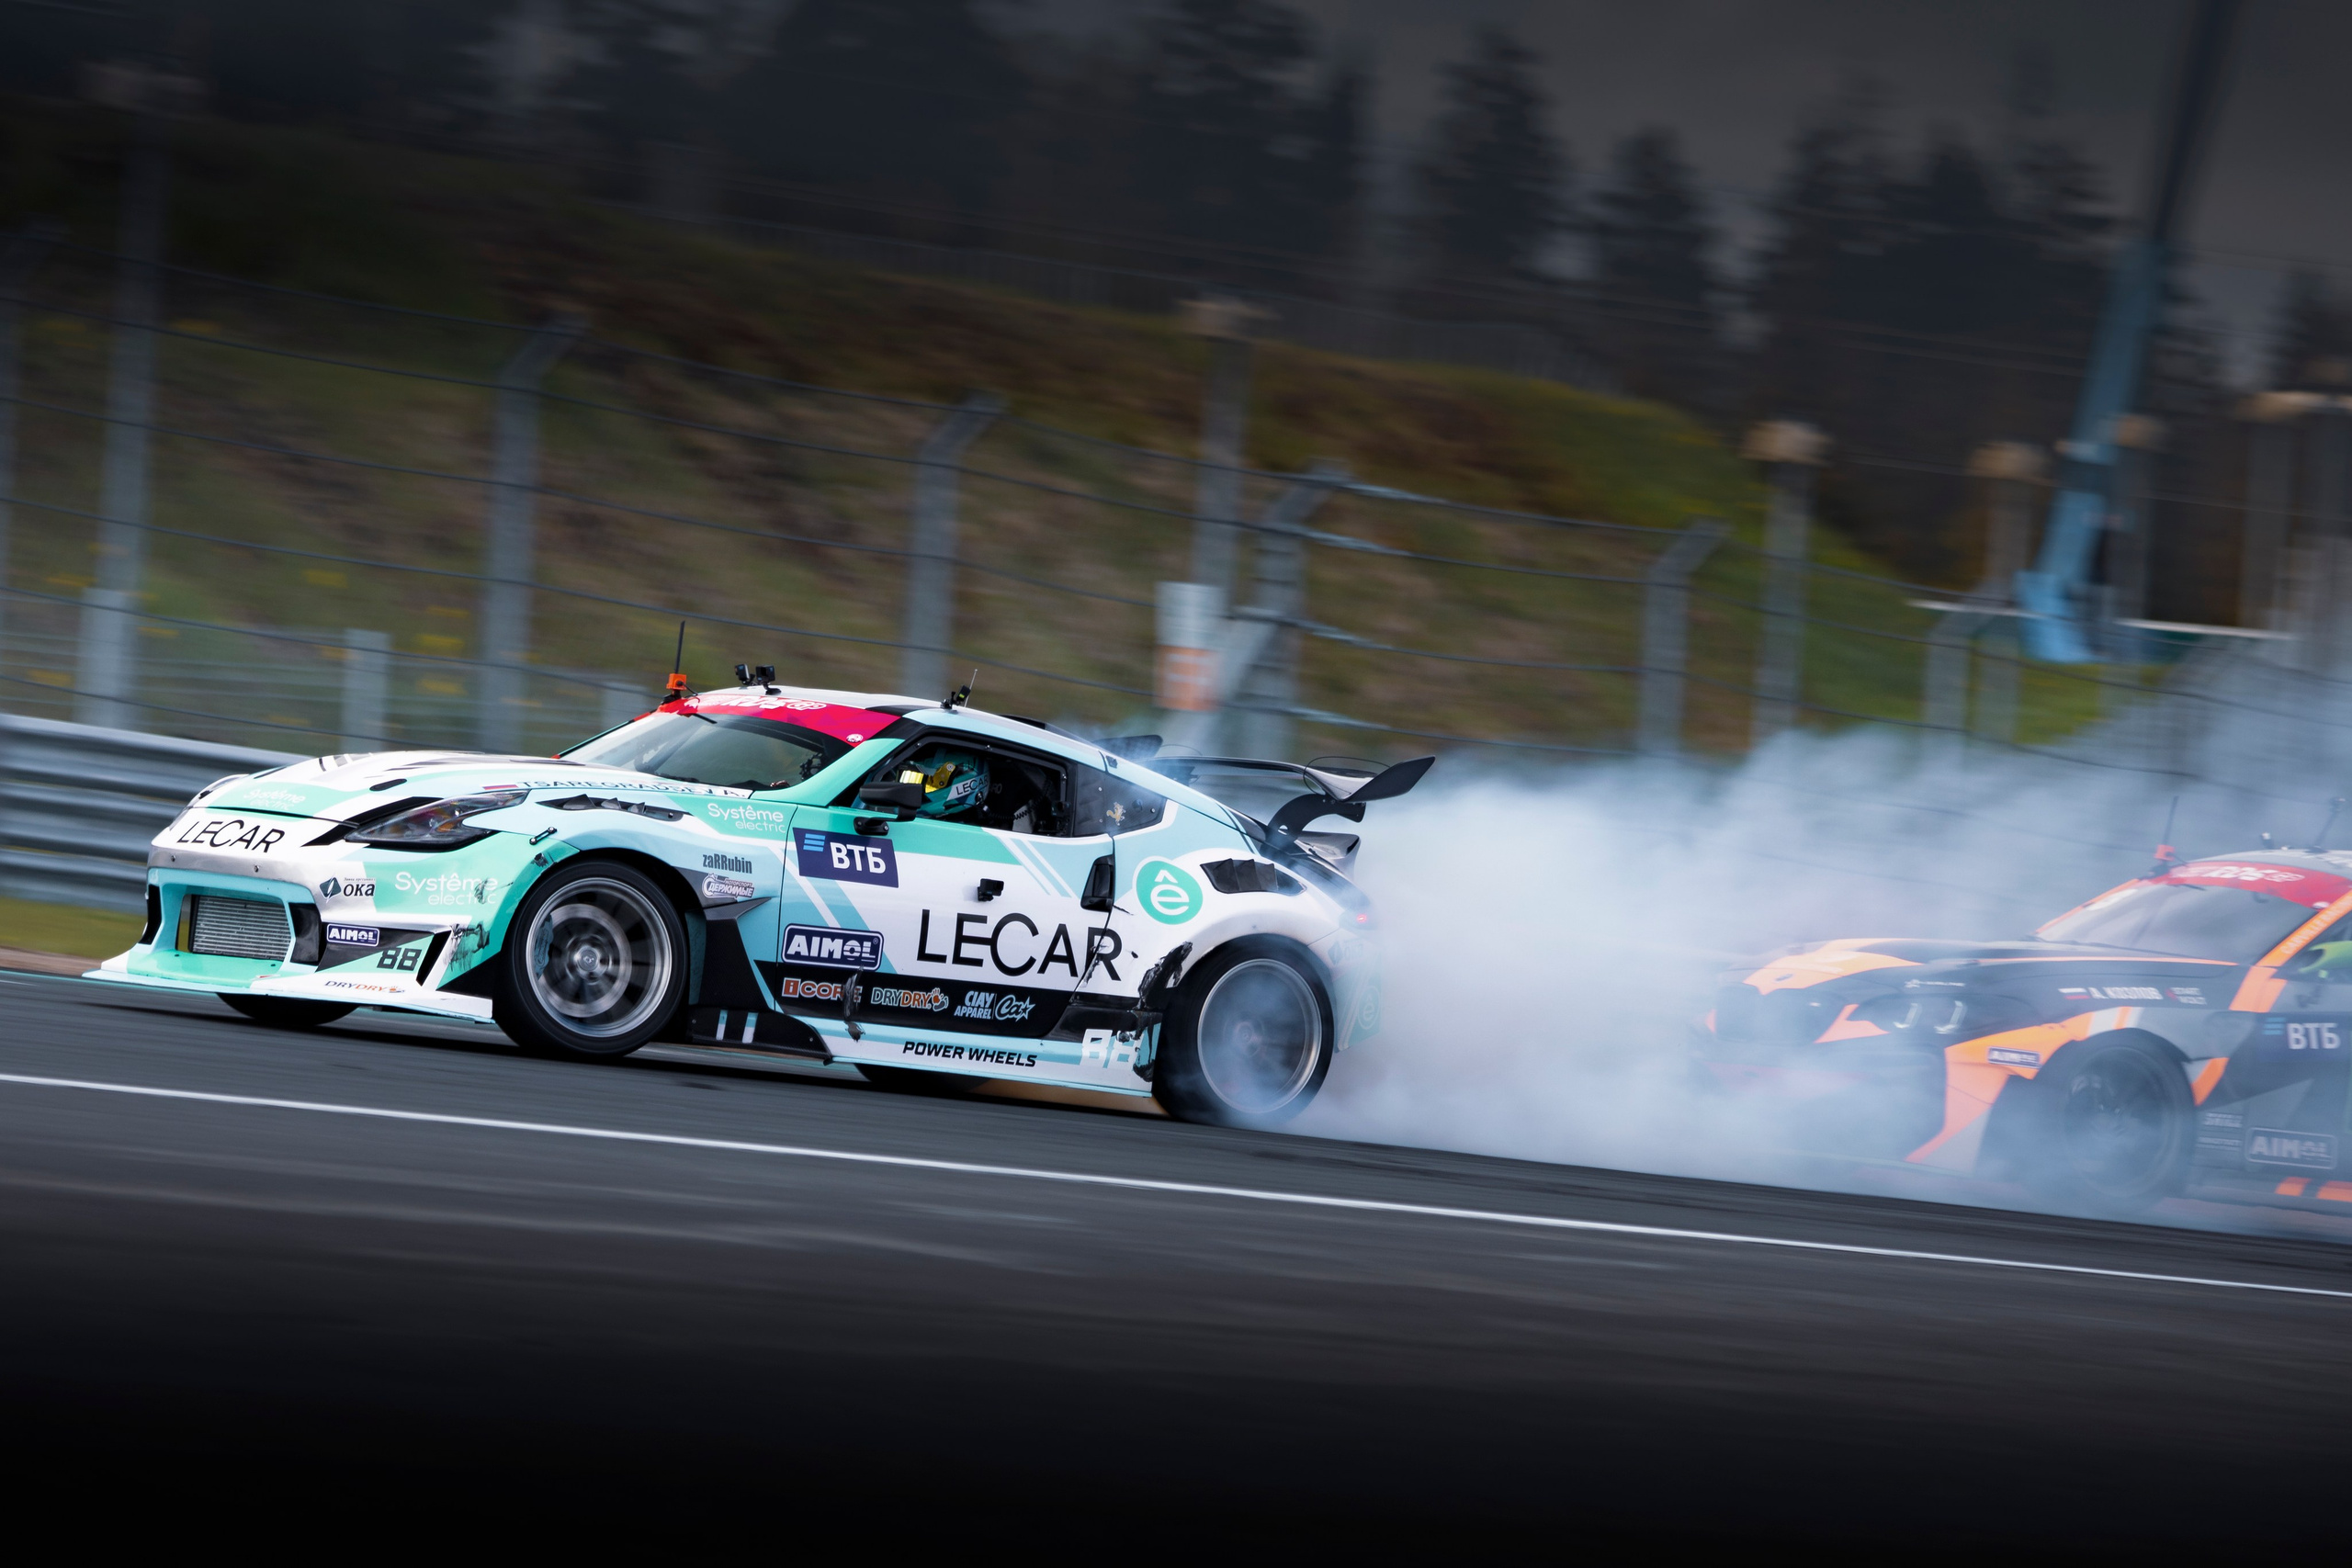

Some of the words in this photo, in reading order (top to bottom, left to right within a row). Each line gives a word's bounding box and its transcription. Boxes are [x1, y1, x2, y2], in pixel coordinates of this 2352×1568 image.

[707, 803, 784, 824] Système
[735, 820, 786, 833] electric
[176, 819, 285, 853] LECAR
[703, 853, 752, 874] zaRRubin
[830, 842, 887, 874] ВТБ
[786, 934, 876, 963] AIMOL
[916, 908, 1123, 981] LECAR
[378, 947, 422, 971] 88
[954, 1005, 991, 1020] APPAREL
[2287, 1022, 2341, 1050] ВТБ
[902, 1041, 964, 1060] POWER
[968, 1047, 1037, 1067] WHEELS
